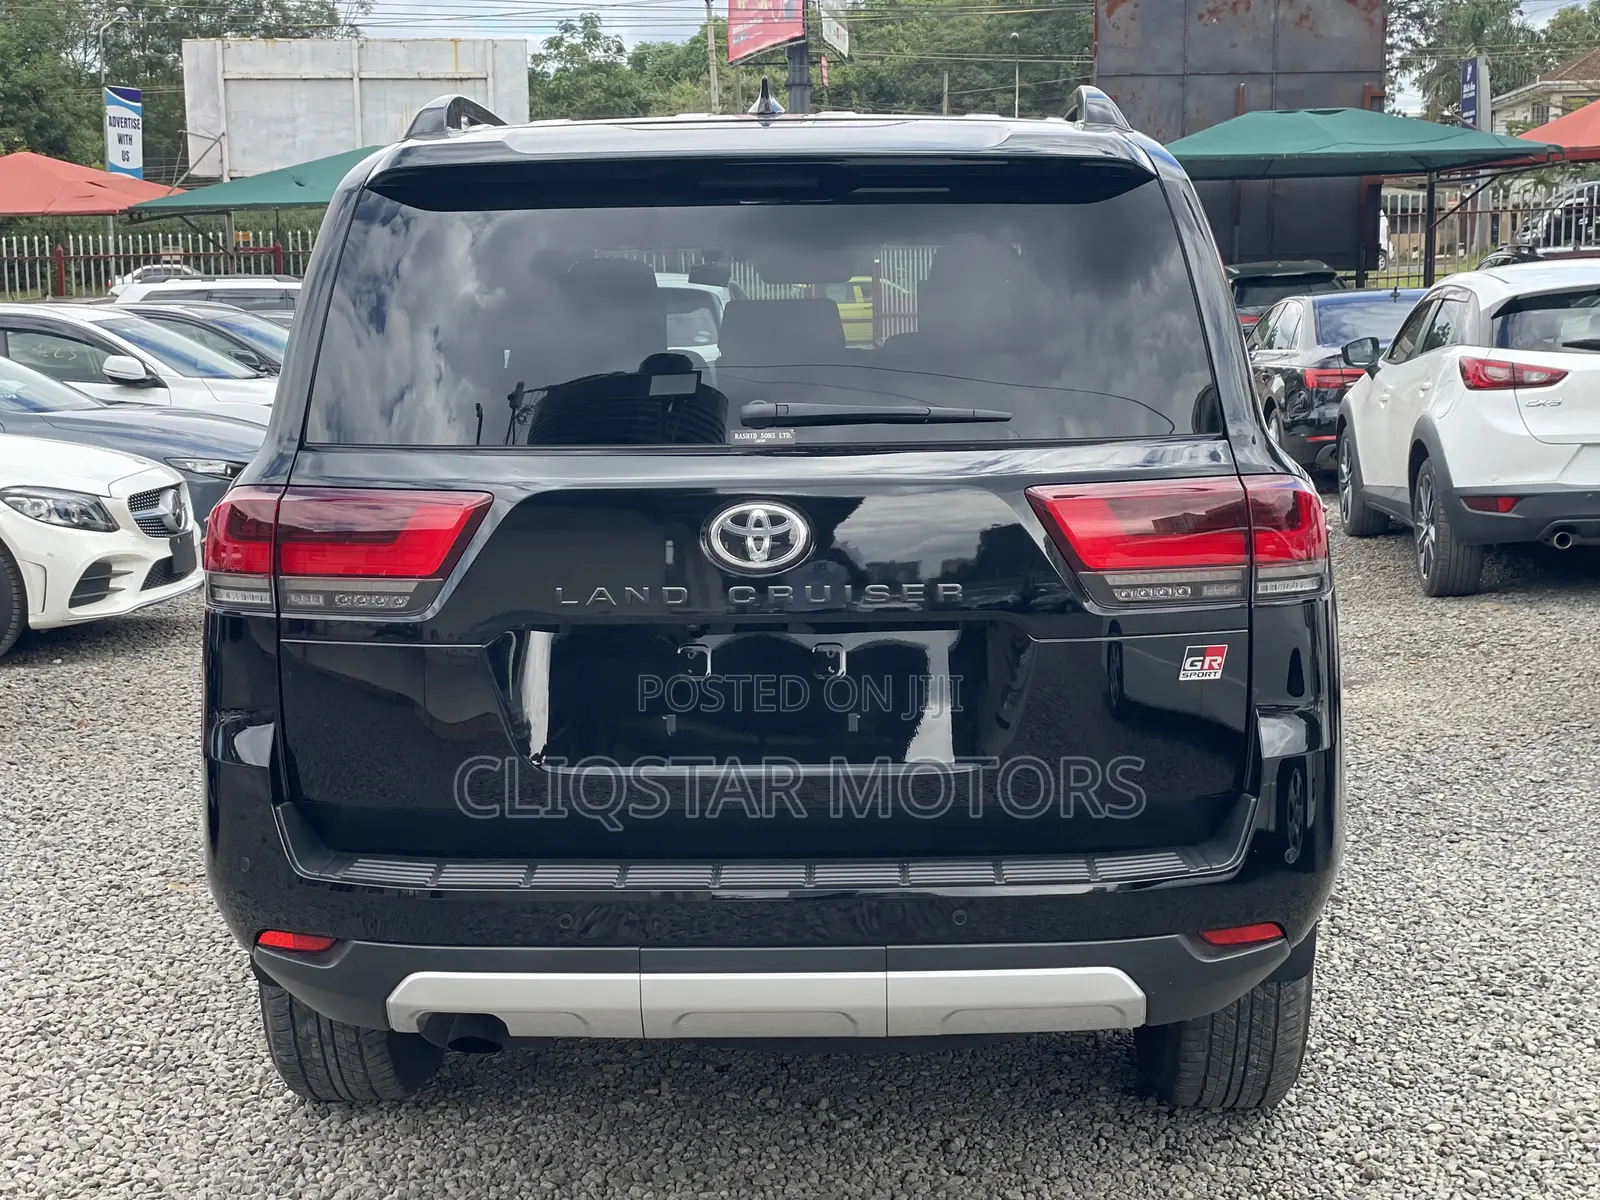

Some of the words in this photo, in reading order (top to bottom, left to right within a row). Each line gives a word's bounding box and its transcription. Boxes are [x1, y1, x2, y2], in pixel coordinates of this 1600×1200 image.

[108, 115, 141, 130] ADVERTISE
[117, 133, 133, 146] WITH
[121, 150, 130, 162] US
[555, 586, 689, 606] LAND
[728, 584, 964, 604] CRUISER
[1184, 655, 1222, 670] GR
